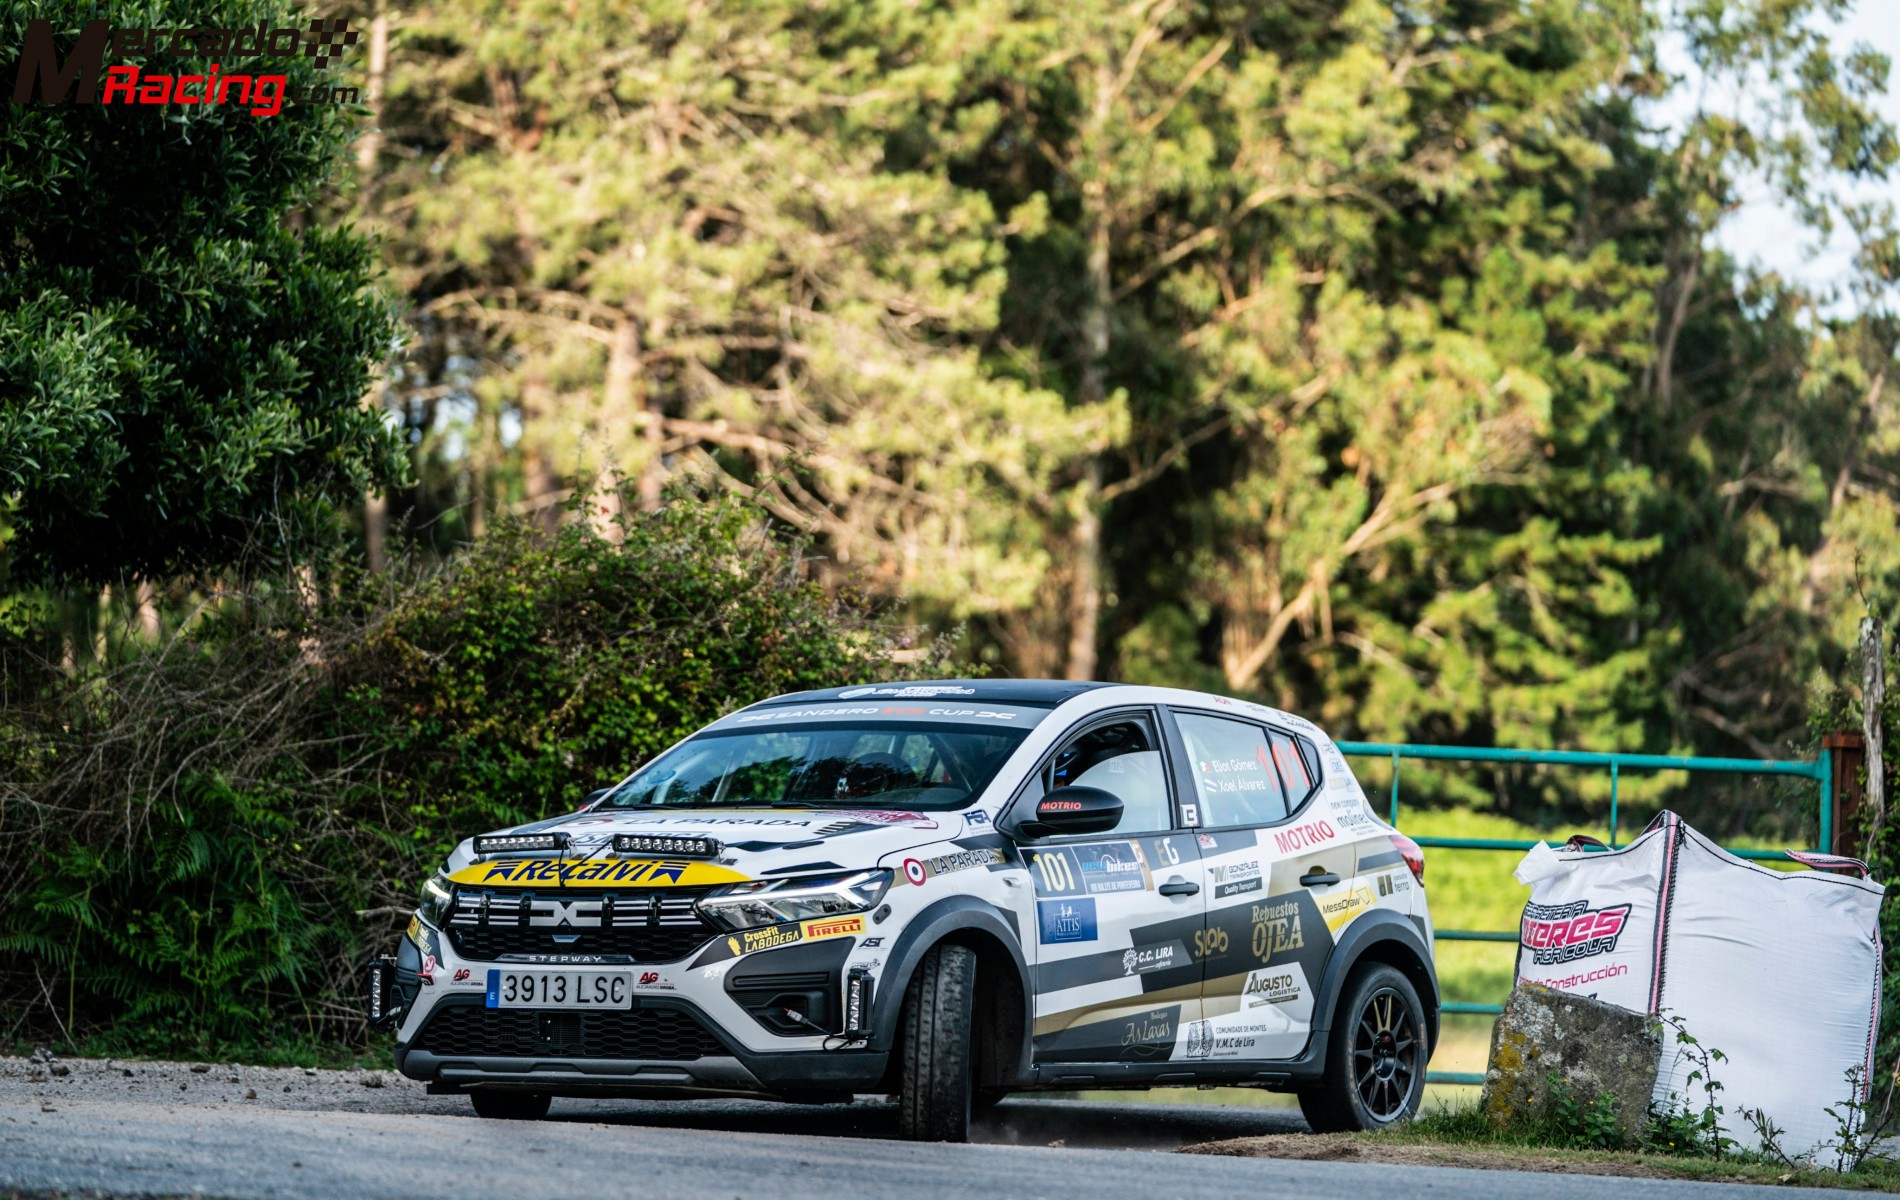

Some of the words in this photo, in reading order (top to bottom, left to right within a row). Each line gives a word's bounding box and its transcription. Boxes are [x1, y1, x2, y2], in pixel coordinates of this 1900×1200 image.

[774, 707, 879, 719] SANDERO
[929, 708, 976, 717] CUP
[1211, 760, 1231, 772] Eliot
[1232, 758, 1257, 771] Gómez
[1256, 739, 1312, 793] 101
[1218, 779, 1238, 792] Xoel
[1238, 776, 1266, 790] Álvarez
[1041, 802, 1082, 811] MOTRIO
[674, 818, 812, 827] PARADA
[1274, 820, 1335, 854] MOTRIO
[929, 859, 950, 875] LA
[951, 850, 996, 870] PARADA
[511, 860, 658, 882] Recalvi
[1033, 852, 1076, 892] 101
[1224, 883, 1239, 894] Quality
[1239, 881, 1257, 892] Transport
[1251, 900, 1299, 924] Repuestos
[1322, 896, 1360, 914] MessDraw
[807, 919, 862, 937] PIRELLI
[1057, 918, 1080, 933] ATTIS
[744, 926, 779, 942] CrossFit
[745, 930, 799, 953] LABODEGA
[1252, 915, 1304, 964] OJEA
[1139, 950, 1154, 962] C.C.
[1155, 946, 1173, 960] LIRA
[453, 969, 471, 980] AG
[639, 972, 659, 983] AG
[504, 975, 567, 1003] 3913
[576, 976, 625, 1004] LSC
[1245, 973, 1292, 994] AUGUSTO
[490, 992, 496, 1000] E
[1151, 1011, 1168, 1020] Bodegas
[1122, 1022, 1141, 1046] As
[1142, 1020, 1170, 1041] Laxas
[1235, 1038, 1242, 1048] de
[1243, 1037, 1255, 1047] Lira
